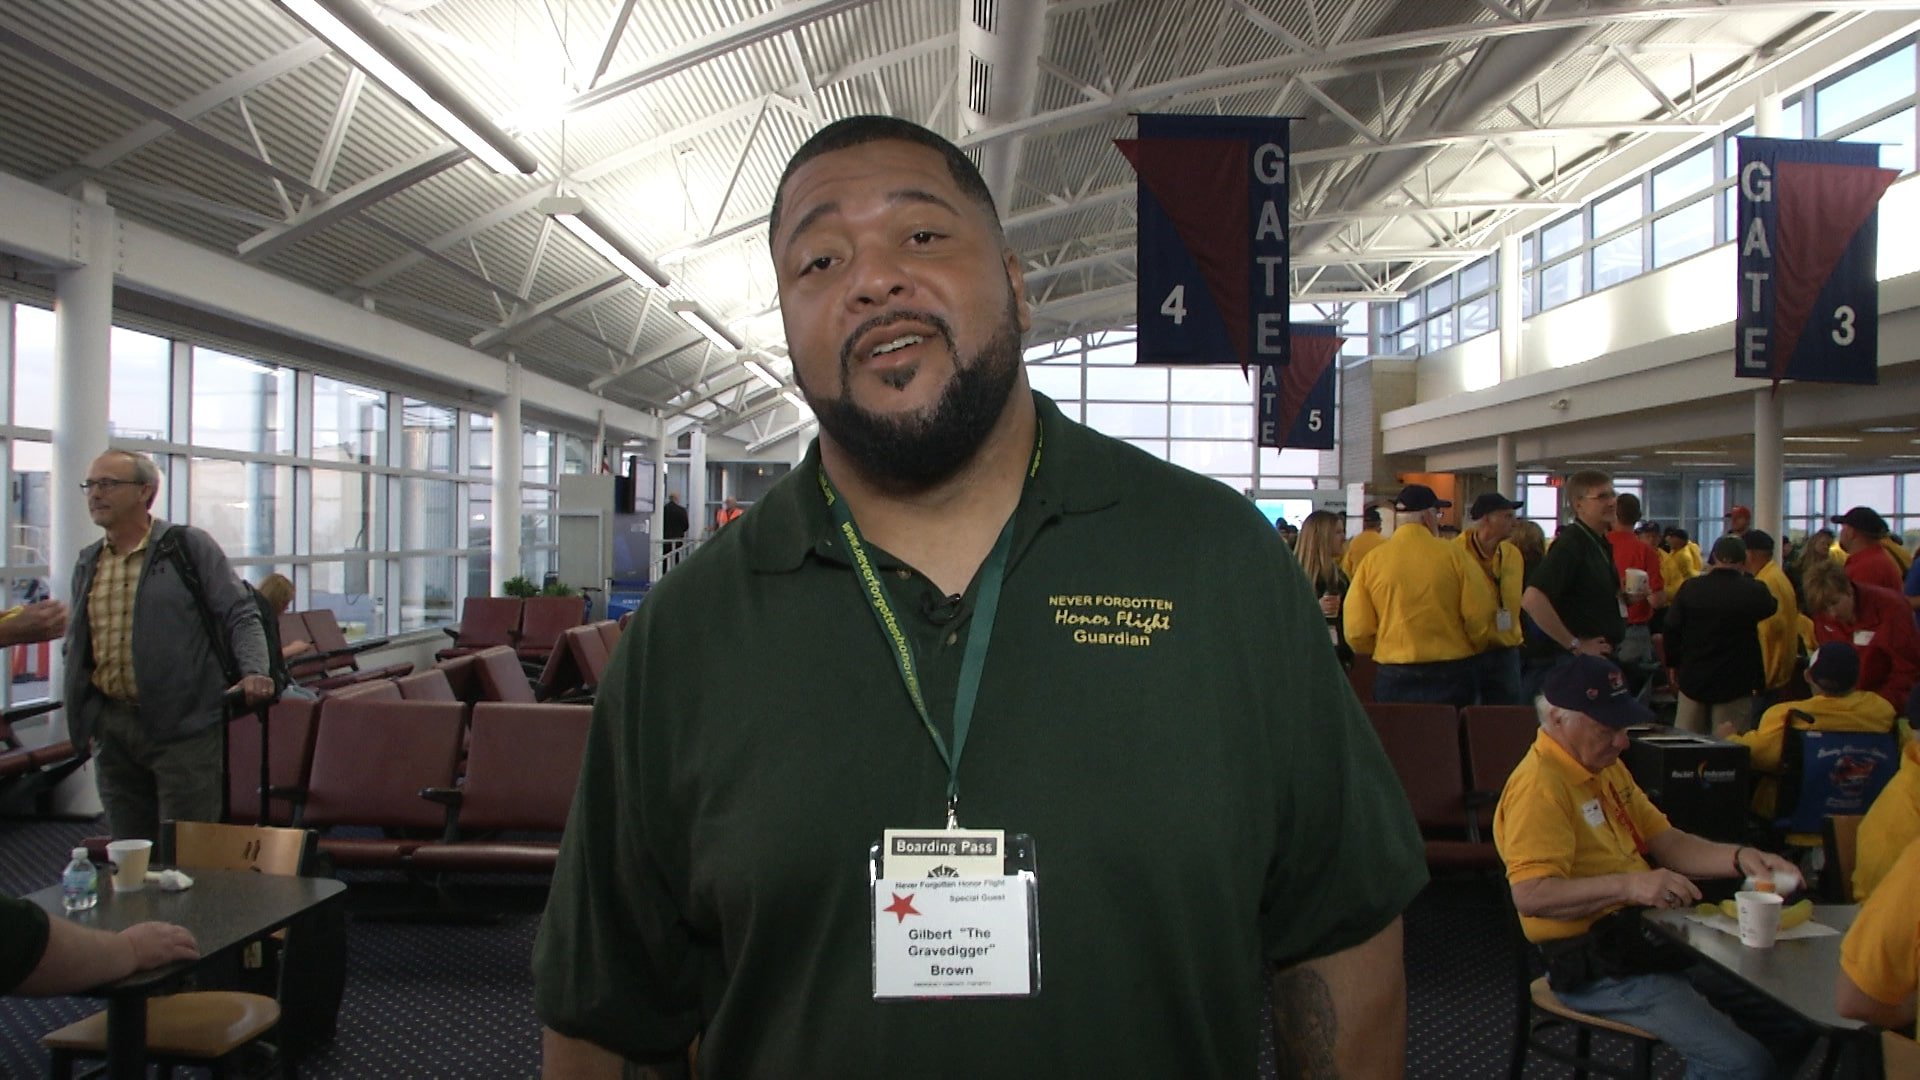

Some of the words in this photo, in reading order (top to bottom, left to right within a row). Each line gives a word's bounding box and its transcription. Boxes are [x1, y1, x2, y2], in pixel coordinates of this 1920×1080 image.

[1253, 142, 1286, 355] GATE
[1741, 160, 1772, 369] GATE
[1160, 284, 1188, 325] 4
[1831, 304, 1857, 346] 3
[1261, 365, 1277, 445] ATE
[1308, 408, 1322, 432] 5
[1049, 595, 1093, 606] NEVER
[1095, 595, 1173, 611] FORGOTTEN
[1055, 609, 1111, 626] Honor
[1116, 610, 1170, 634] Flight
[1073, 629, 1150, 646] Guardian
[896, 839, 957, 855] Boarding
[961, 840, 993, 854] Pass
[895, 881, 918, 889] Never
[919, 881, 956, 890] Forgotten
[958, 880, 982, 888] Honor
[983, 879, 1005, 889] Flight
[949, 894, 979, 903] Special
[981, 894, 1005, 902] Guest
[908, 928, 952, 940] Gilbert
[930, 965, 974, 976] Brown
